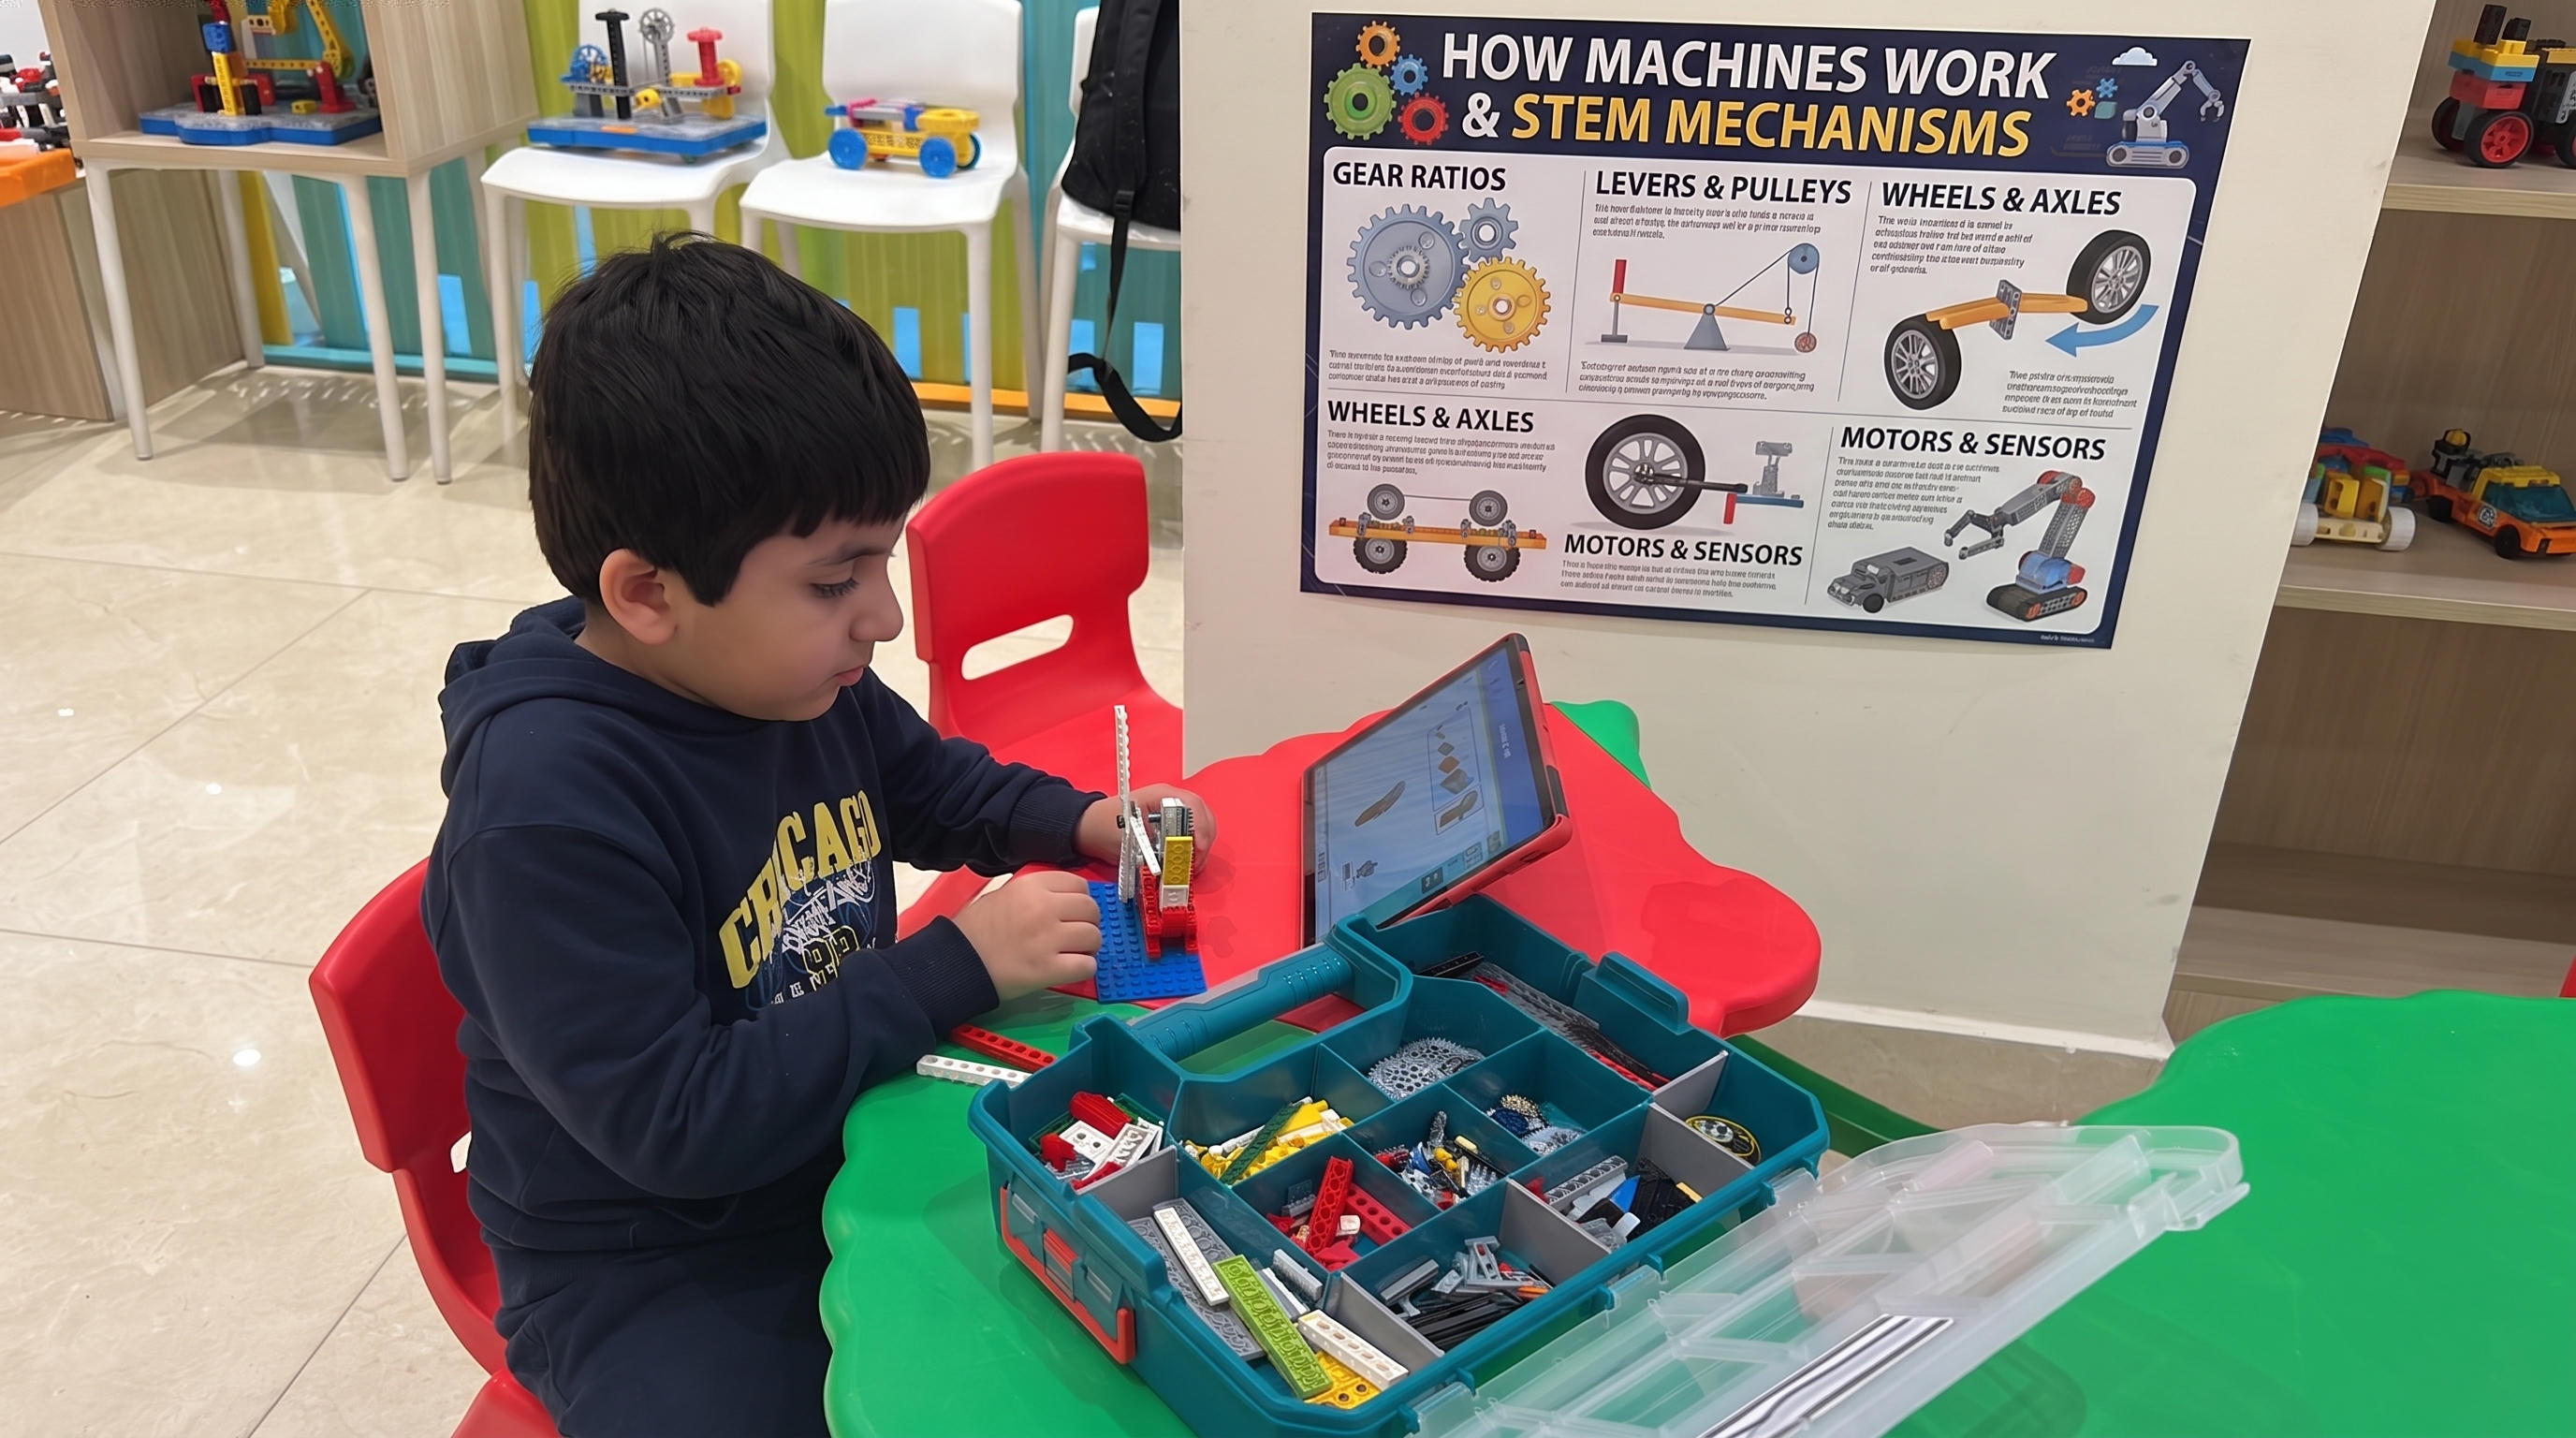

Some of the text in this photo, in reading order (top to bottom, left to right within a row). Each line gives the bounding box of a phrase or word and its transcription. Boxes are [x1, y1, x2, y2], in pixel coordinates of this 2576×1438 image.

[1442, 33, 2057, 99] HOW MACHINES WORK
[1462, 92, 2032, 157] & STEM MECHANISMS
[1333, 161, 1506, 191] GEAR RATIOS
[1596, 170, 1852, 204] LEVERS & PULLEYS
[1882, 182, 2122, 215] WHEELS & AXLES
[1327, 400, 1534, 433] WHEELS & AXLES
[1840, 426, 2106, 461] MOTORS & SENSORS
[1564, 534, 1803, 566] MOTORS & SENSORS
